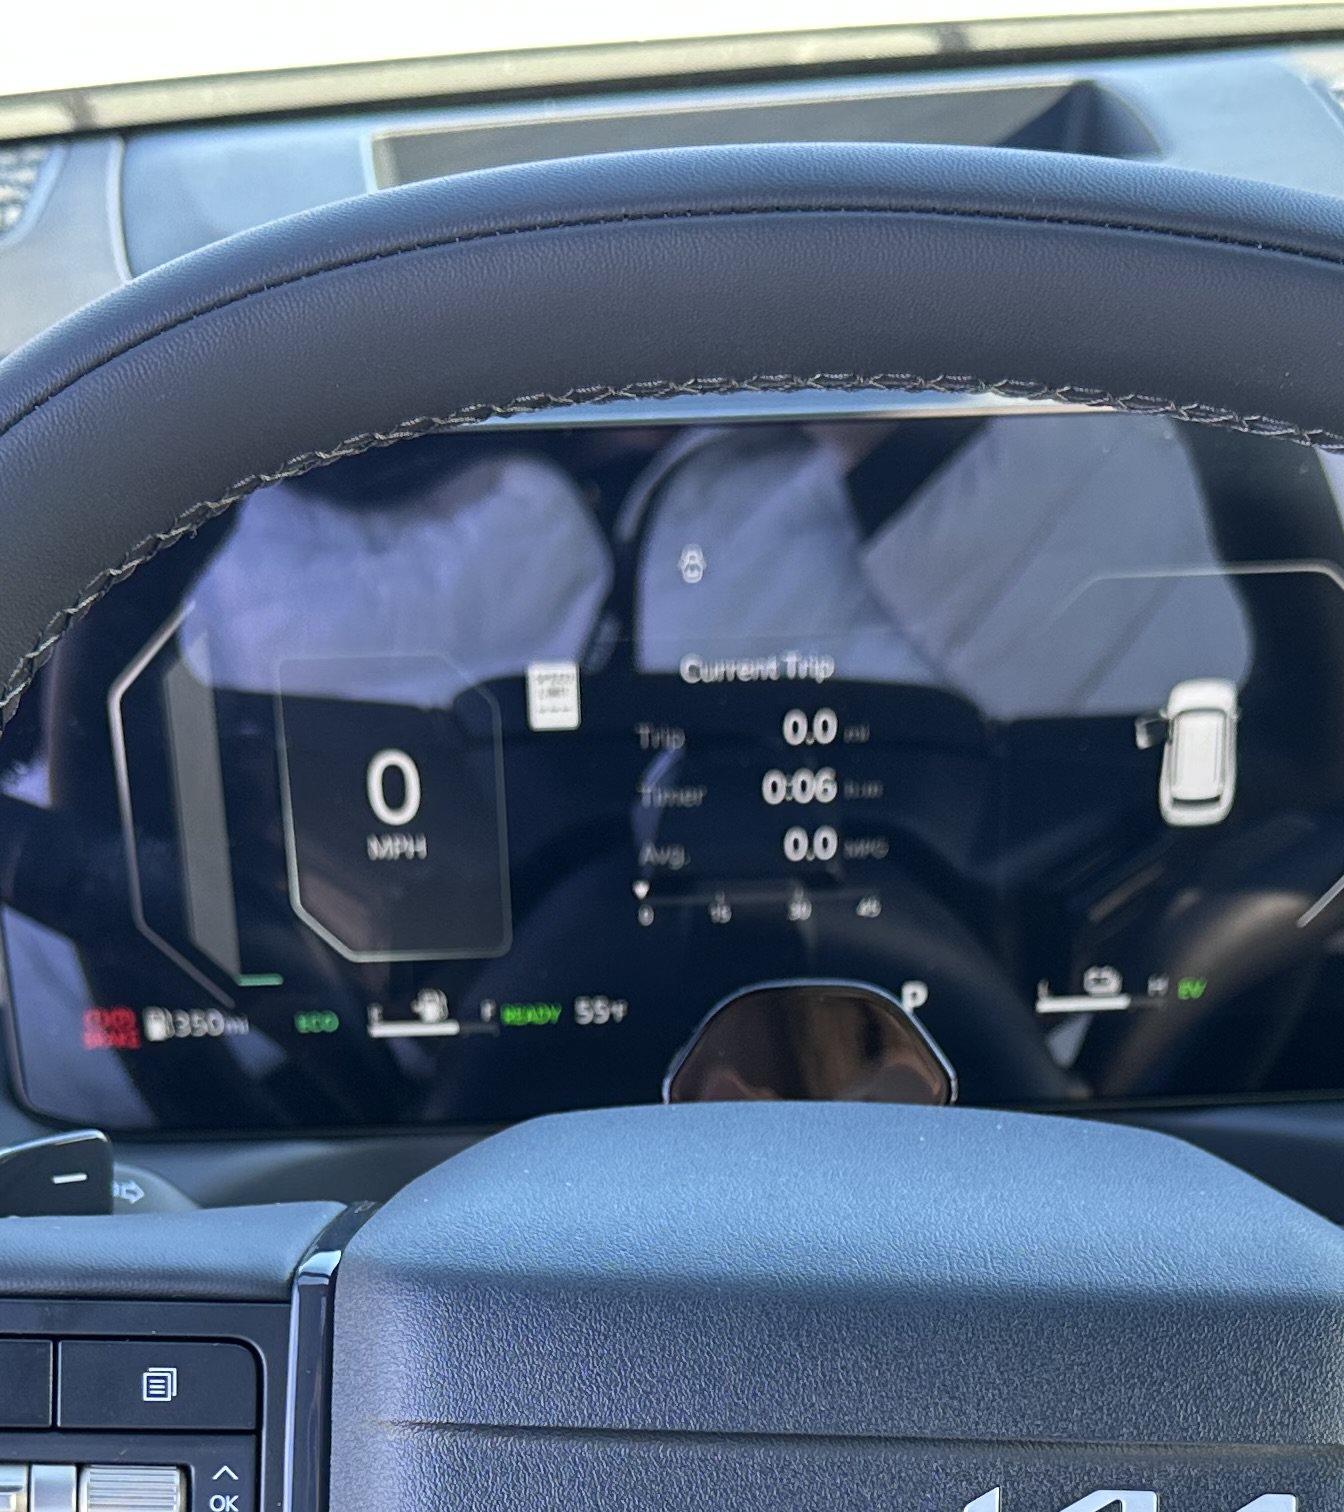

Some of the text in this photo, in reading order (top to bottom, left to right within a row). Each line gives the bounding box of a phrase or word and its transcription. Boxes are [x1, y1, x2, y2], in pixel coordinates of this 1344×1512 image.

[679, 650, 835, 684] Current Trip
[633, 721, 686, 750] Trip
[782, 707, 838, 746] 0.0
[366, 748, 421, 826] 0
[761, 766, 838, 805] 0:06
[366, 832, 427, 861] MPH
[782, 825, 838, 862] 0.0
[901, 980, 929, 1014] P
[209, 1494, 239, 1512] OK
